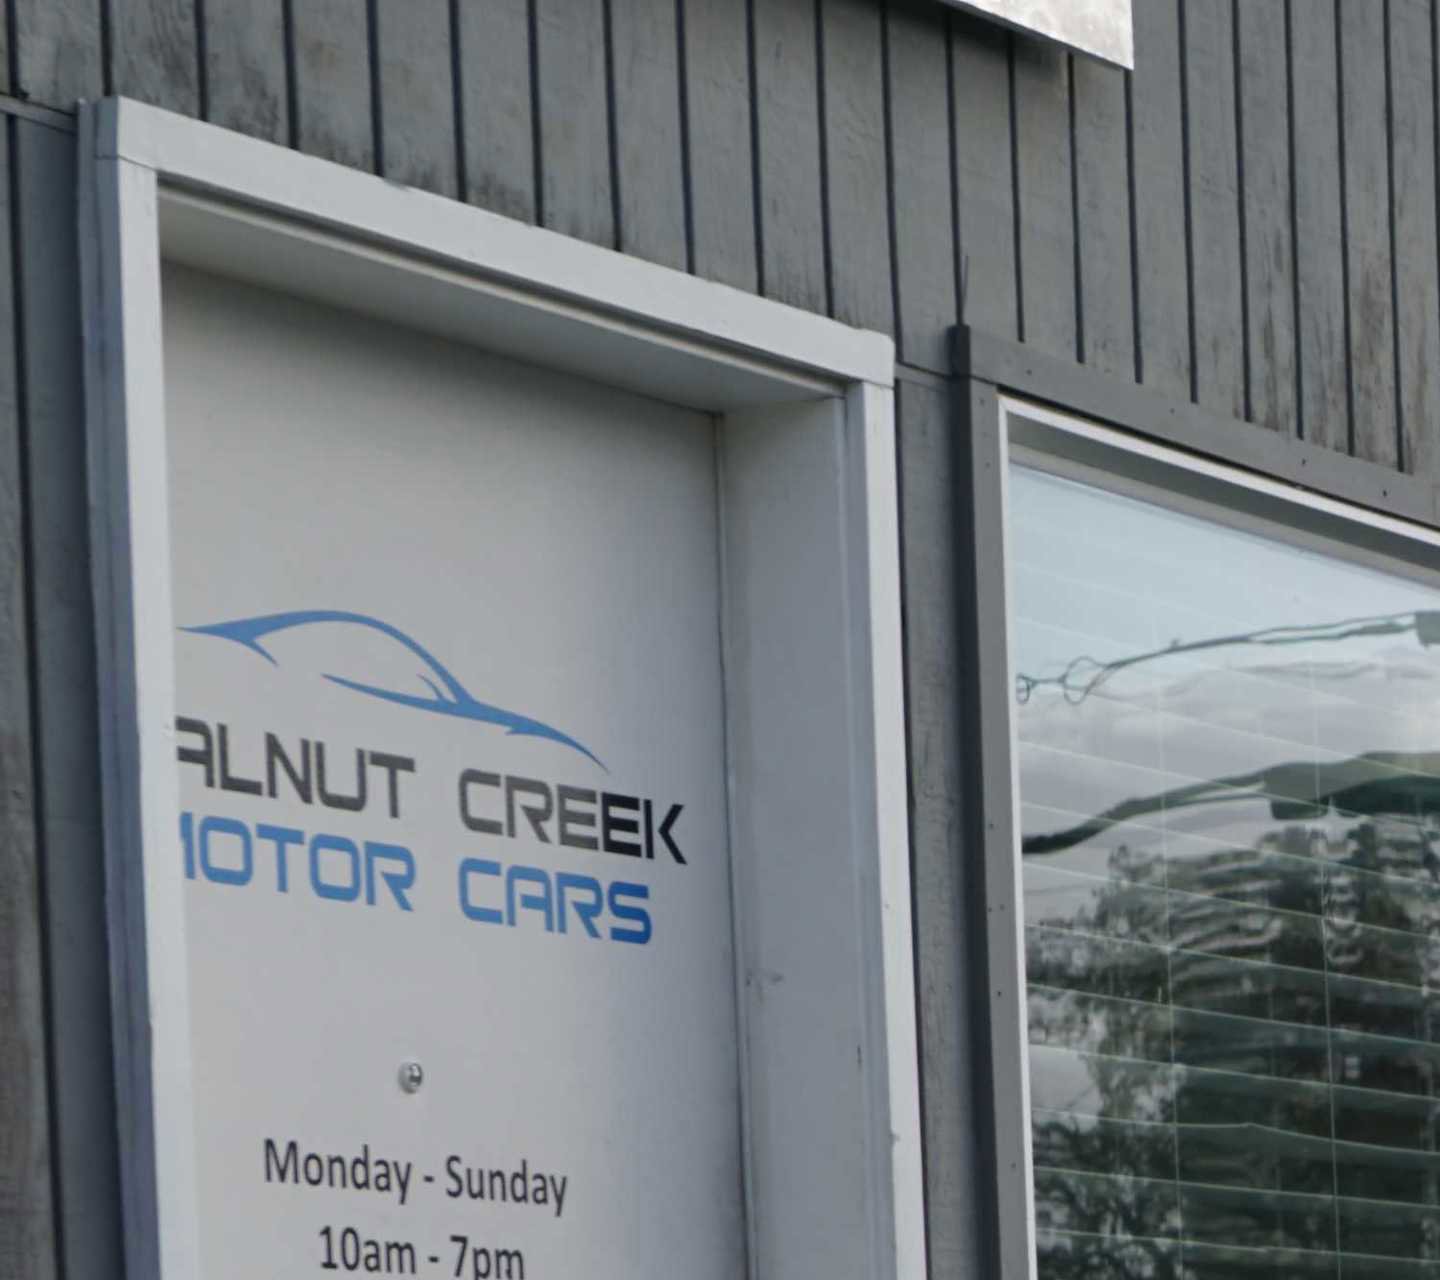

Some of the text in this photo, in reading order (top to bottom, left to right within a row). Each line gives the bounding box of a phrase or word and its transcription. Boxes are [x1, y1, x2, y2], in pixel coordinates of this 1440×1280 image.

[175, 715, 688, 866] ALNUT CREEK
[458, 857, 654, 945] CARS
[263, 1138, 413, 1204] Monday
[445, 1155, 568, 1217] Sunday
[319, 1225, 416, 1275] 10am
